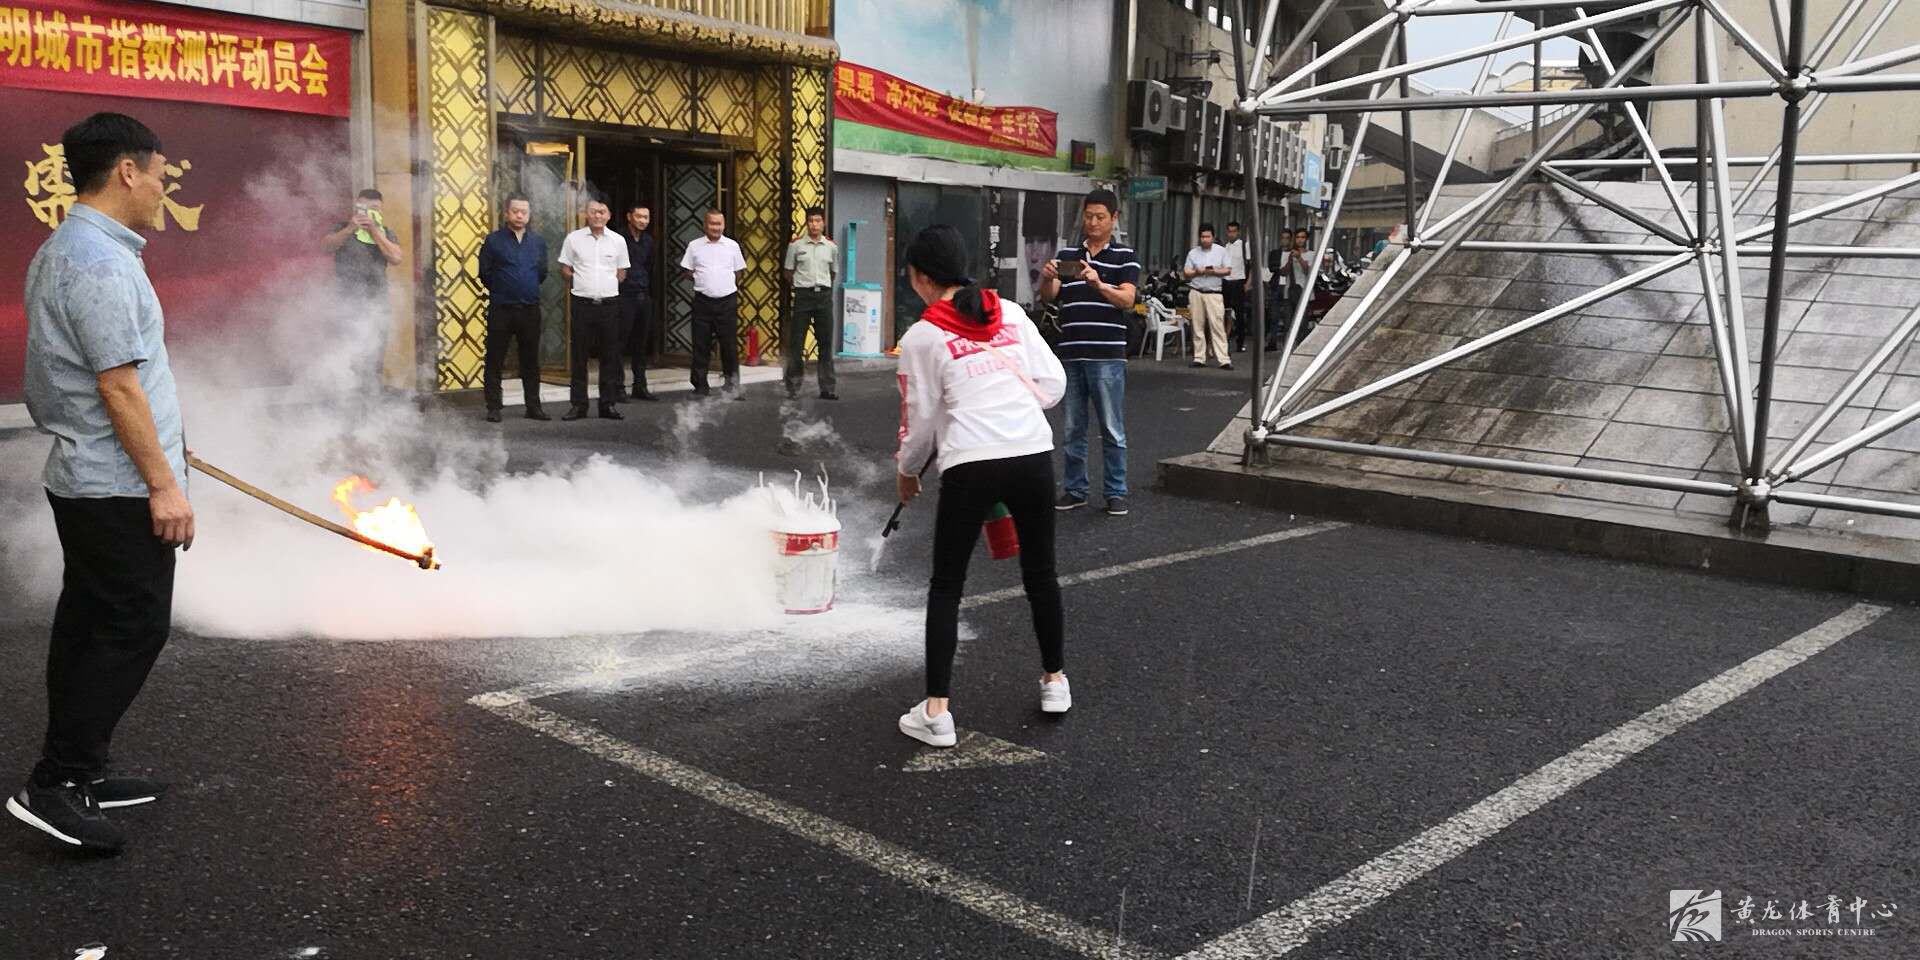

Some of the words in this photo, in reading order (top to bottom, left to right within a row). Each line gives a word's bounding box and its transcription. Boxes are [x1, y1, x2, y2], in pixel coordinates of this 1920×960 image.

[0, 7, 329, 97] 明城市指数测评动员会
